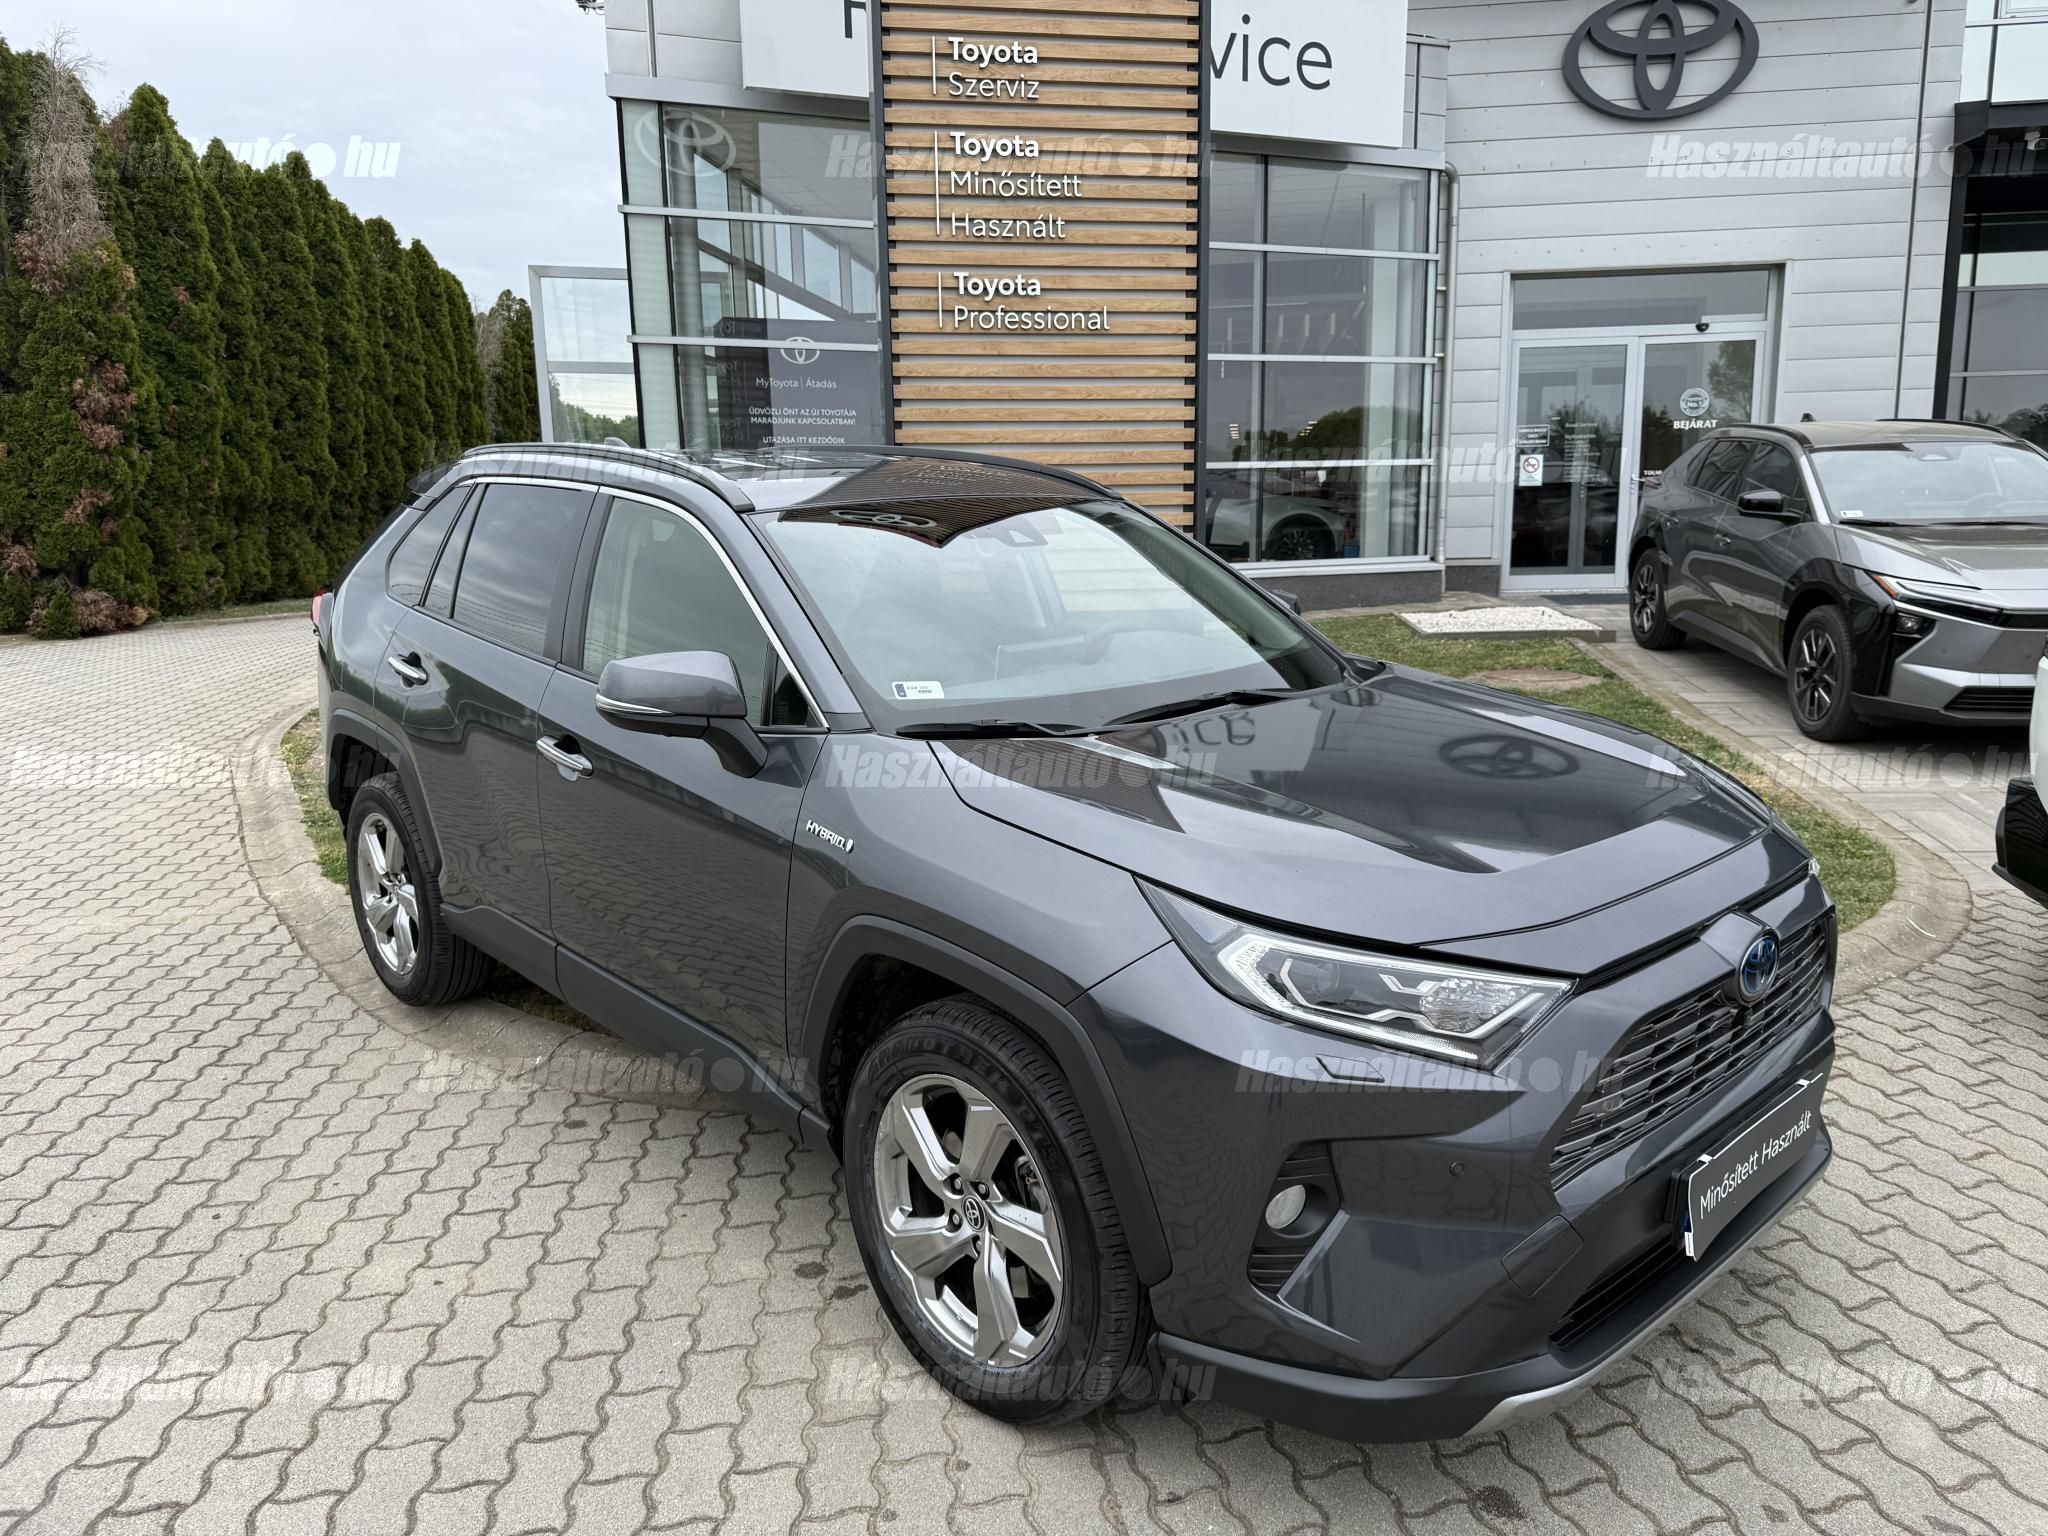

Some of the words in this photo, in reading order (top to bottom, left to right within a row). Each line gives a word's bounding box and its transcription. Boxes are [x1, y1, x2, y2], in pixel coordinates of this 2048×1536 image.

[947, 36, 1039, 69] Toyota
[948, 72, 1040, 99] Szerviz
[950, 131, 1040, 163] Toyota
[950, 171, 1083, 198] Minősített
[951, 212, 1066, 238] Használt
[953, 271, 1041, 301] Toyota
[954, 305, 1110, 331] Professional
[755, 378, 799, 390] MyToyota
[805, 377, 837, 389] Átadás
[750, 417, 796, 425] MARADJUNK
[800, 408, 810, 416] AZ
[1673, 418, 1718, 430] BEJÁRAT
[762, 435, 796, 444] UTAZÁSA
[805, 820, 846, 850] HYBRID
[1700, 1150, 1758, 1220] Minősített
[1761, 1109, 1812, 1165] Használt
